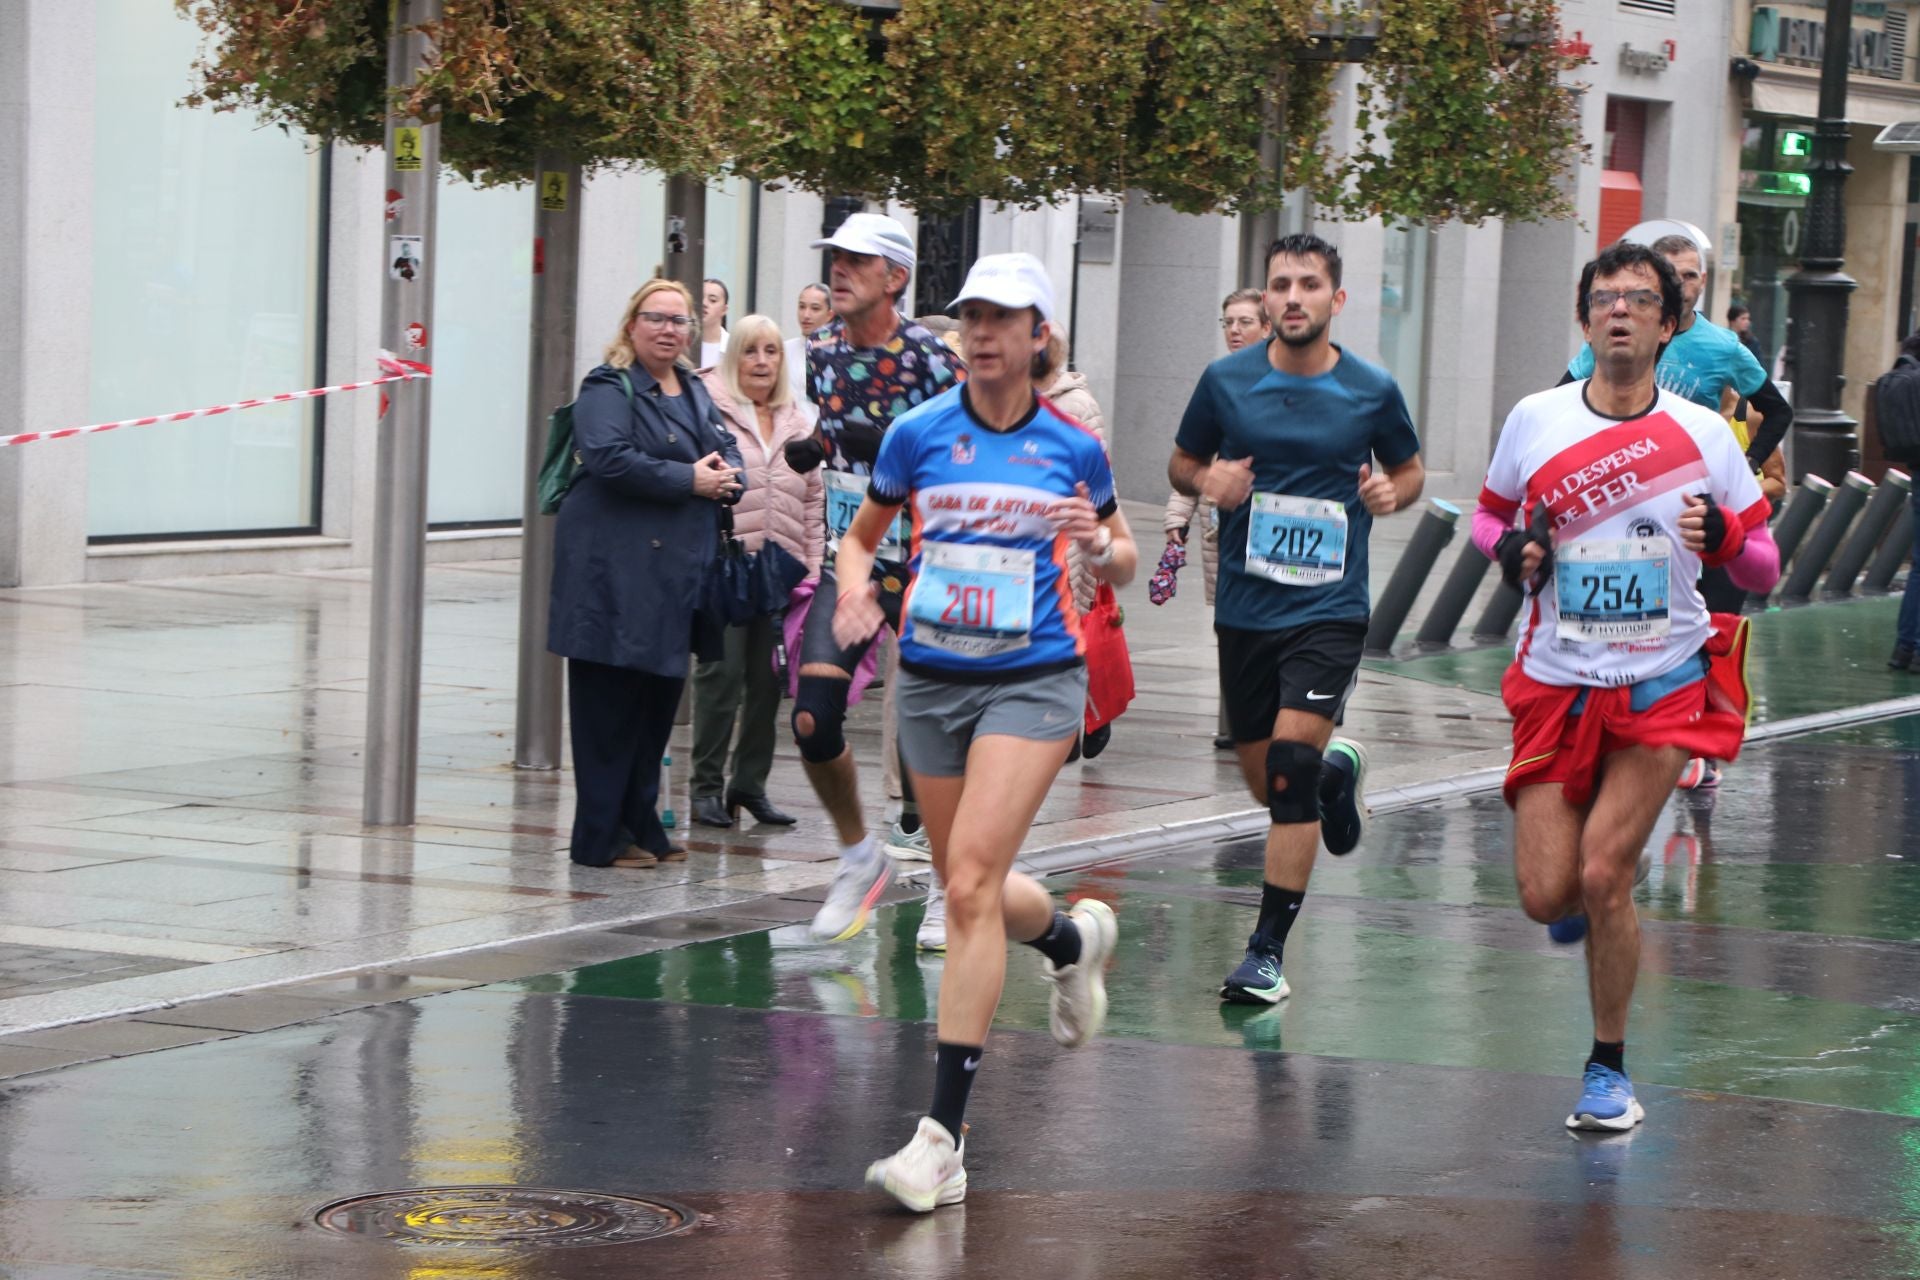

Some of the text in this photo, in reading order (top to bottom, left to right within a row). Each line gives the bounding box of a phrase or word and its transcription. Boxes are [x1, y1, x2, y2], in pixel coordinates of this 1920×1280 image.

[1541, 437, 1661, 508] LA DESPENSA
[1554, 471, 1650, 530] DE FER
[1269, 525, 1323, 559] 202
[939, 583, 996, 629] 201
[1581, 573, 1644, 610] 254
